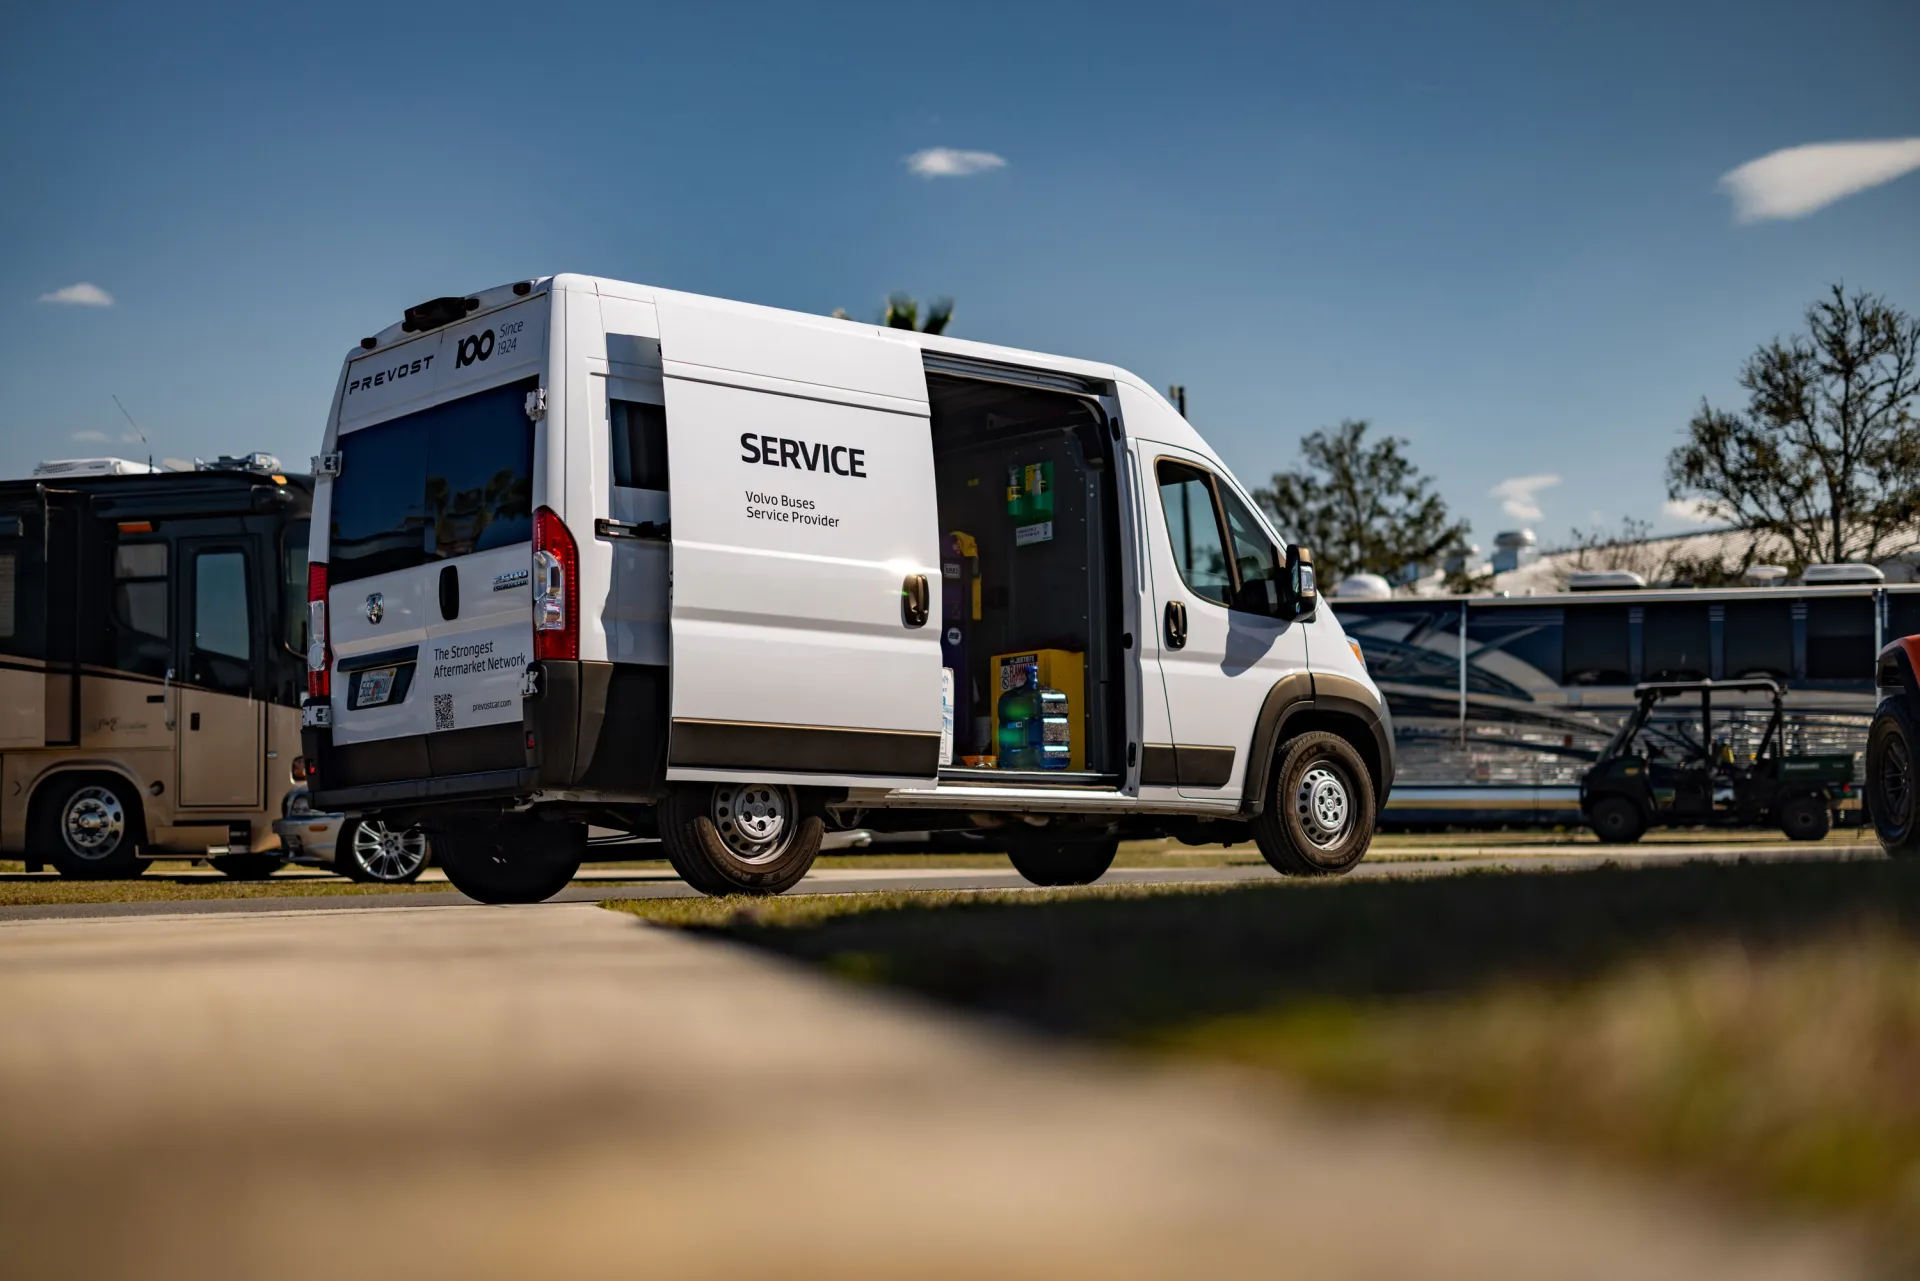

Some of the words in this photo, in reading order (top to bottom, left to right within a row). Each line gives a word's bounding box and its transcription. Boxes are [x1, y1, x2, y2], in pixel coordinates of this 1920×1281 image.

[499, 320, 523, 338] Since
[455, 329, 495, 369] 100
[497, 337, 517, 356] 1924
[348, 355, 434, 395] PREVOST
[740, 432, 867, 478] SERVICE
[745, 491, 778, 506] Volvo
[781, 495, 815, 510] Buses
[746, 506, 789, 522] Service
[791, 511, 840, 527] Provider
[434, 648, 450, 661] The
[451, 641, 494, 660] Strongest
[433, 660, 486, 679] Aftermarket
[487, 652, 526, 671] Network
[472, 699, 512, 712] prevostcar.com
